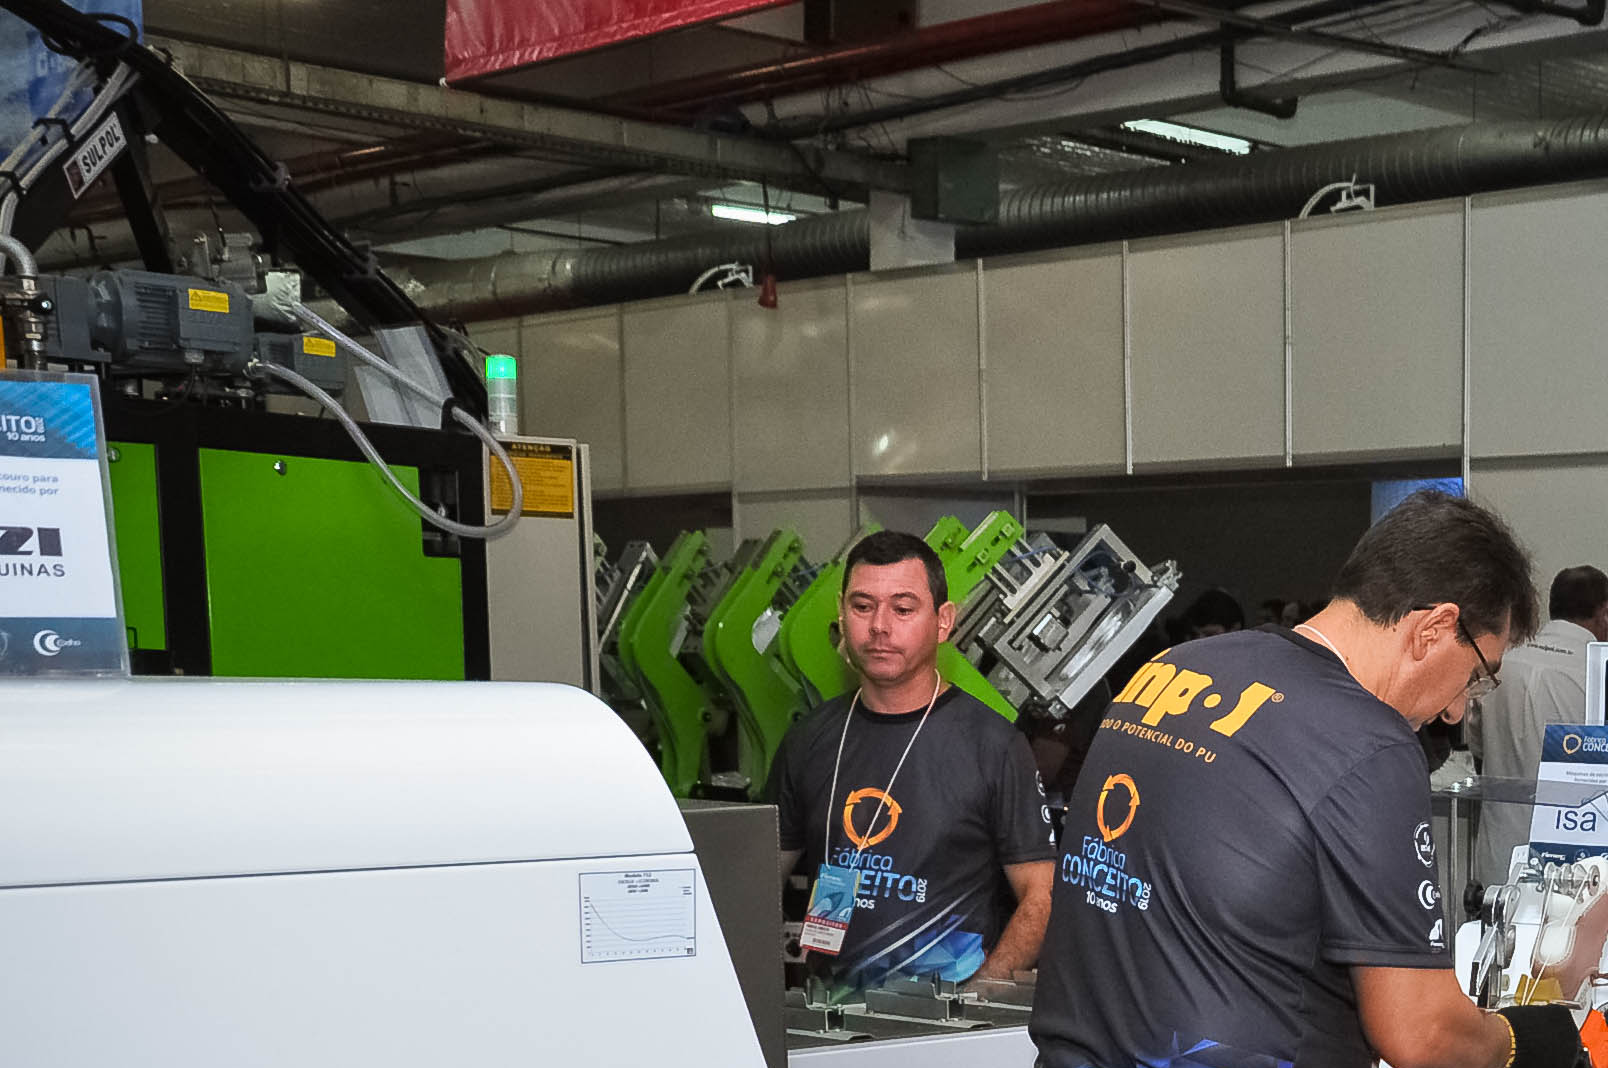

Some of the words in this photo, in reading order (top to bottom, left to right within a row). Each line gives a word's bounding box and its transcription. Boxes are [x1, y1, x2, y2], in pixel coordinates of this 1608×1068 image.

[81, 126, 121, 174] SULPOL
[7, 431, 19, 441] 10
[1121, 722, 1172, 747] POTENCIAL
[1174, 738, 1194, 753] DO
[1196, 747, 1217, 763] PU
[830, 846, 893, 871] Fábrica
[857, 870, 917, 901] EITO
[916, 878, 928, 903] 2019
[1062, 853, 1143, 906] CONCEITO
[1086, 891, 1096, 905] 10
[1137, 882, 1152, 910] 2019
